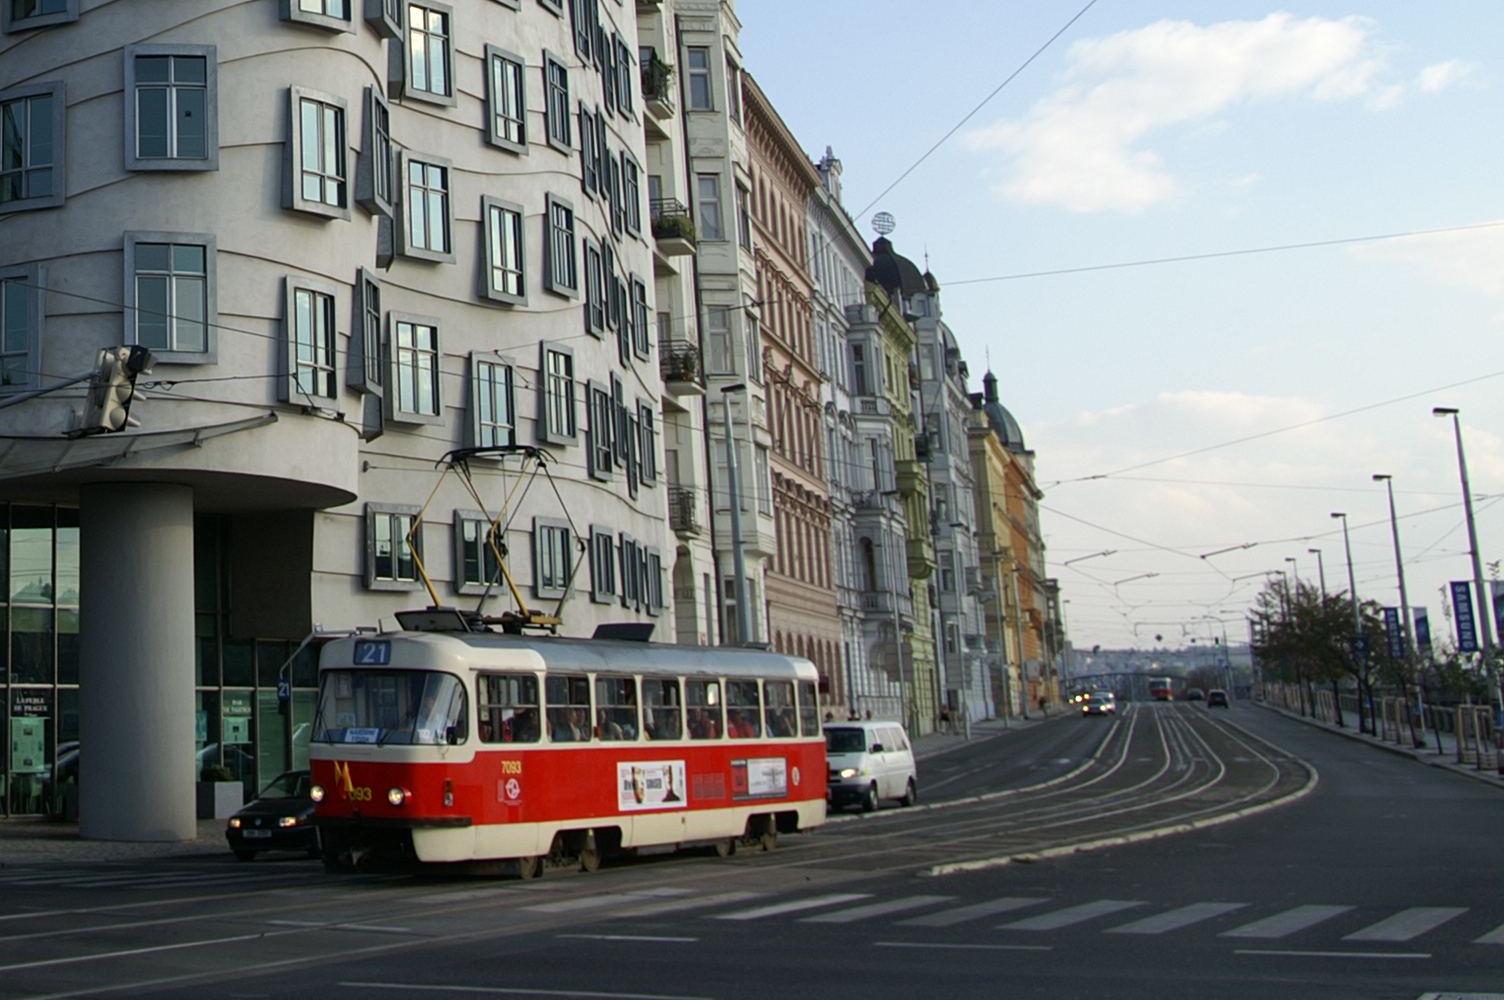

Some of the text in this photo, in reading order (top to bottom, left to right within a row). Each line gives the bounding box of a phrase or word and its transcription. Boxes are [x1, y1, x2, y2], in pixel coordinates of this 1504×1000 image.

[1454, 585, 1474, 649] SAMSUNG
[361, 643, 386, 663] 21
[278, 682, 290, 697] 21
[501, 760, 522, 774] 7093
[343, 786, 372, 802] 093
